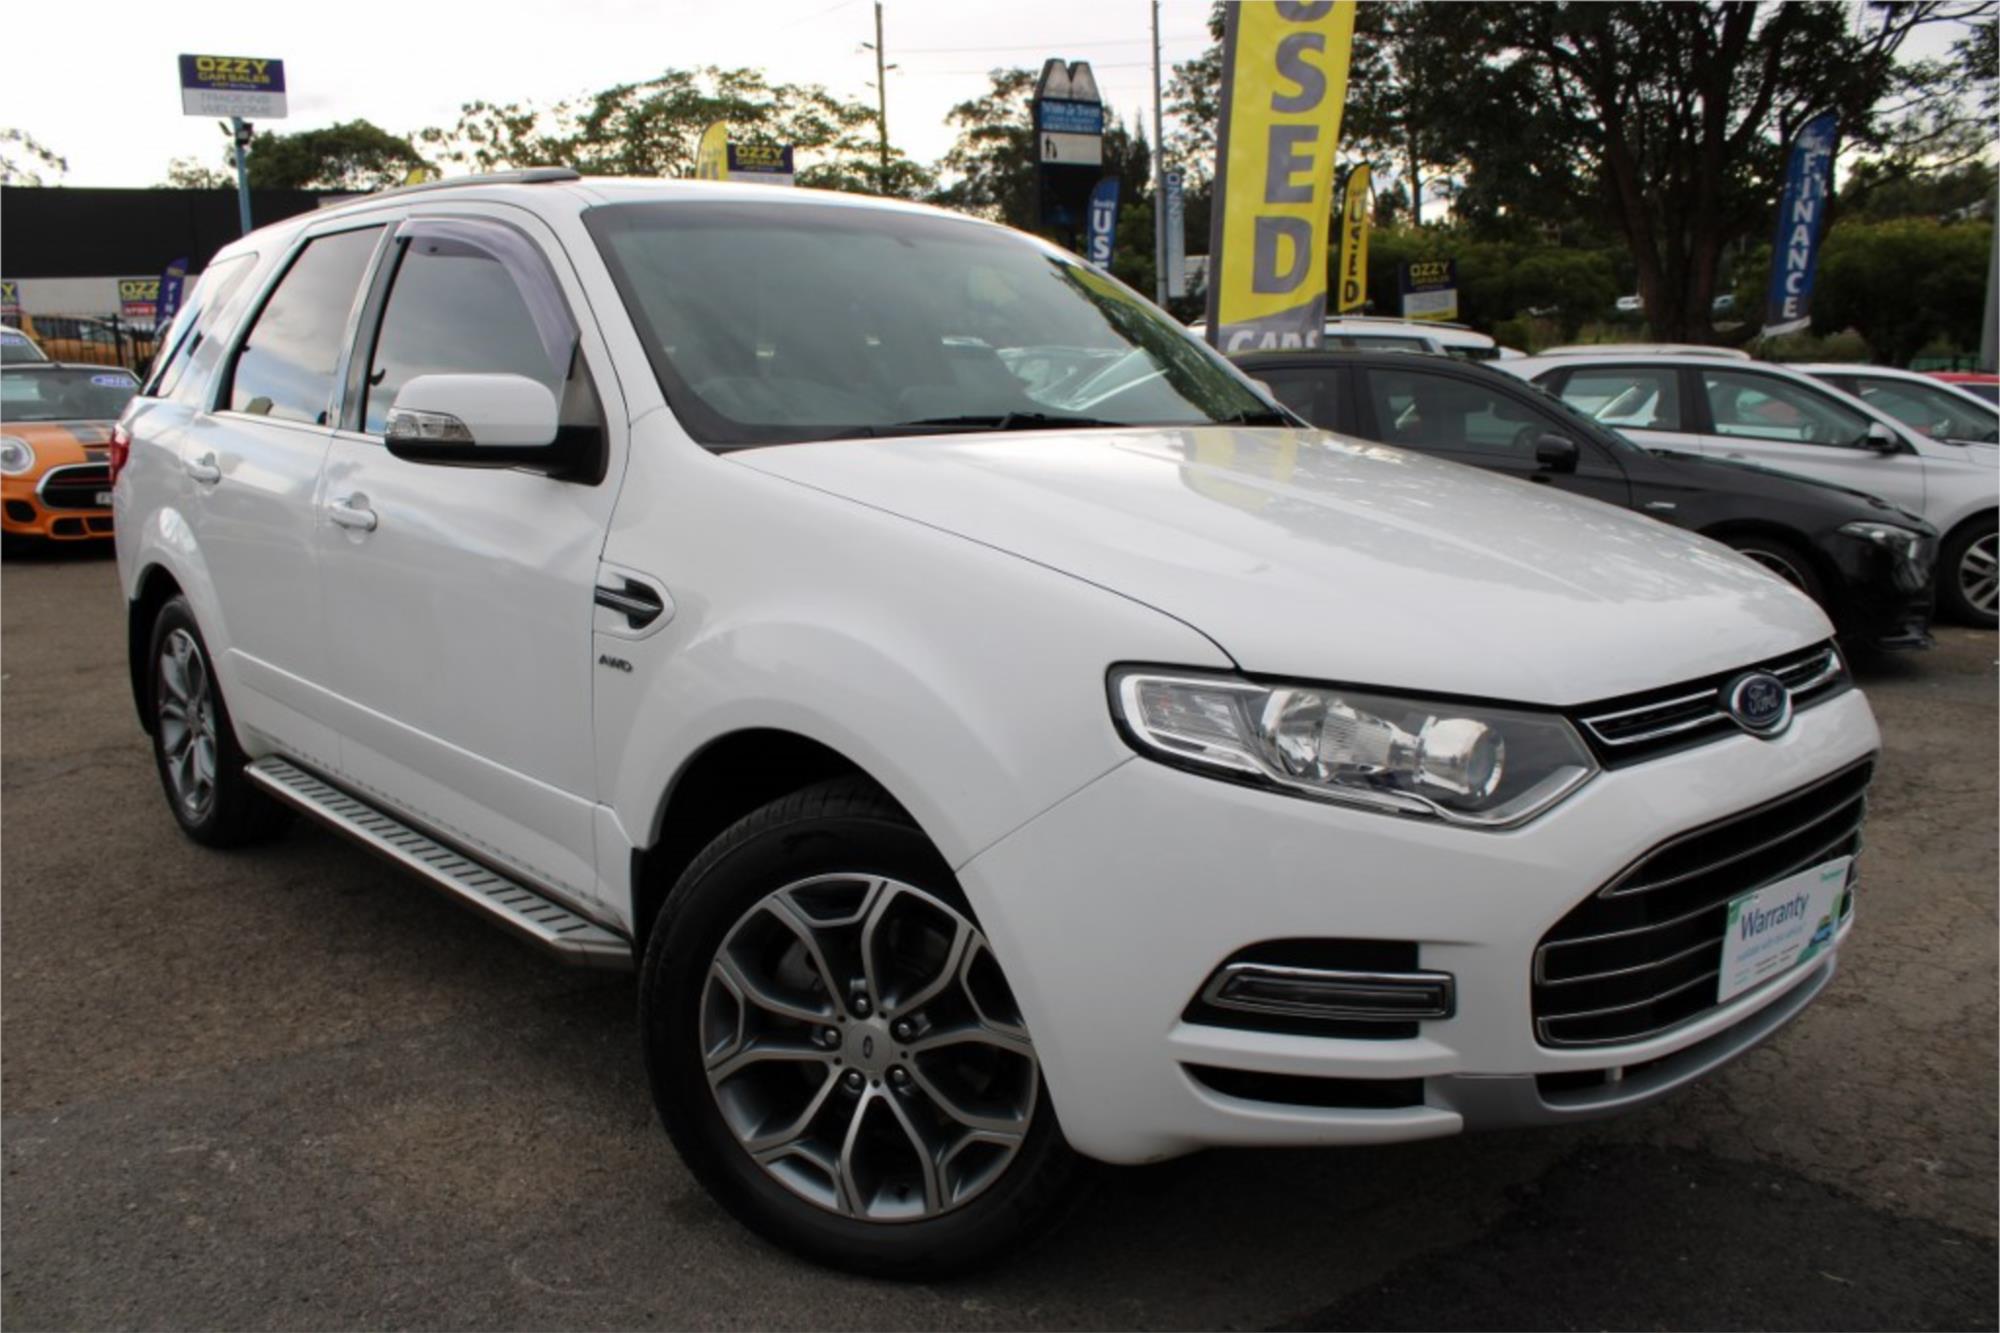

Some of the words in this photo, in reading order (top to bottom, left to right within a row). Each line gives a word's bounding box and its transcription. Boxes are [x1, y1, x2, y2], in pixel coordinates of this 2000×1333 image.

[196, 57, 268, 73] OZZY
[198, 72, 226, 82] CAR
[228, 73, 270, 84] SALES
[736, 146, 784, 158] OZZY
[1252, 1, 1333, 293] SED
[1783, 152, 1818, 318] FINANCE
[1410, 261, 1449, 276] OZZY
[599, 653, 633, 672] AWD
[1747, 684, 1778, 714] Ford
[1740, 894, 1809, 941] Warranty
